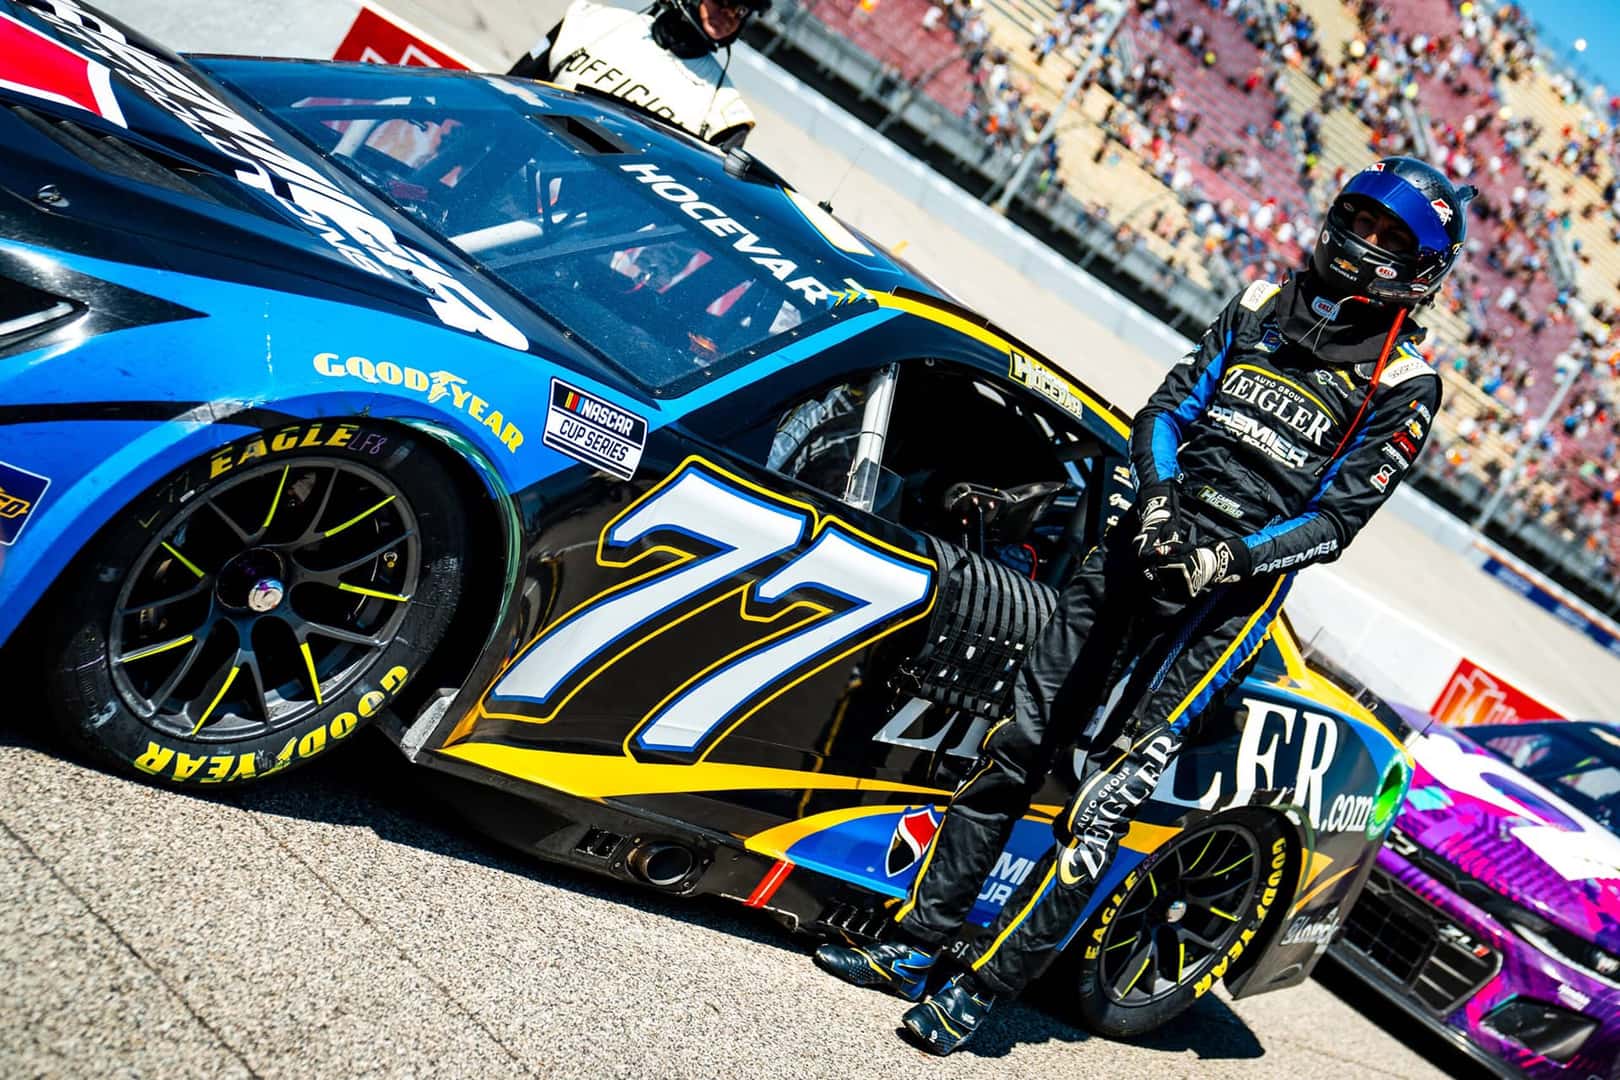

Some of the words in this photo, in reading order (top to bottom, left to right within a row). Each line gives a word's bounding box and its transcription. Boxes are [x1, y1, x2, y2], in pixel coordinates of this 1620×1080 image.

[566, 52, 683, 125] OFFICIA
[619, 163, 833, 305] HOCEVAR
[580, 399, 635, 437] NASCAR
[1222, 368, 1331, 446] ZEIGLER
[1253, 374, 1275, 388] AUTO
[1278, 386, 1305, 404] GROUP
[209, 423, 360, 480] EAGLE
[559, 419, 587, 441] CUP
[584, 425, 630, 463] SERIES
[1207, 405, 1308, 468] PREMIER
[480, 460, 935, 758] 77
[1077, 800, 1099, 829] AUTO
[1098, 766, 1131, 799] GROUP
[1085, 868, 1138, 960] EAGLE
